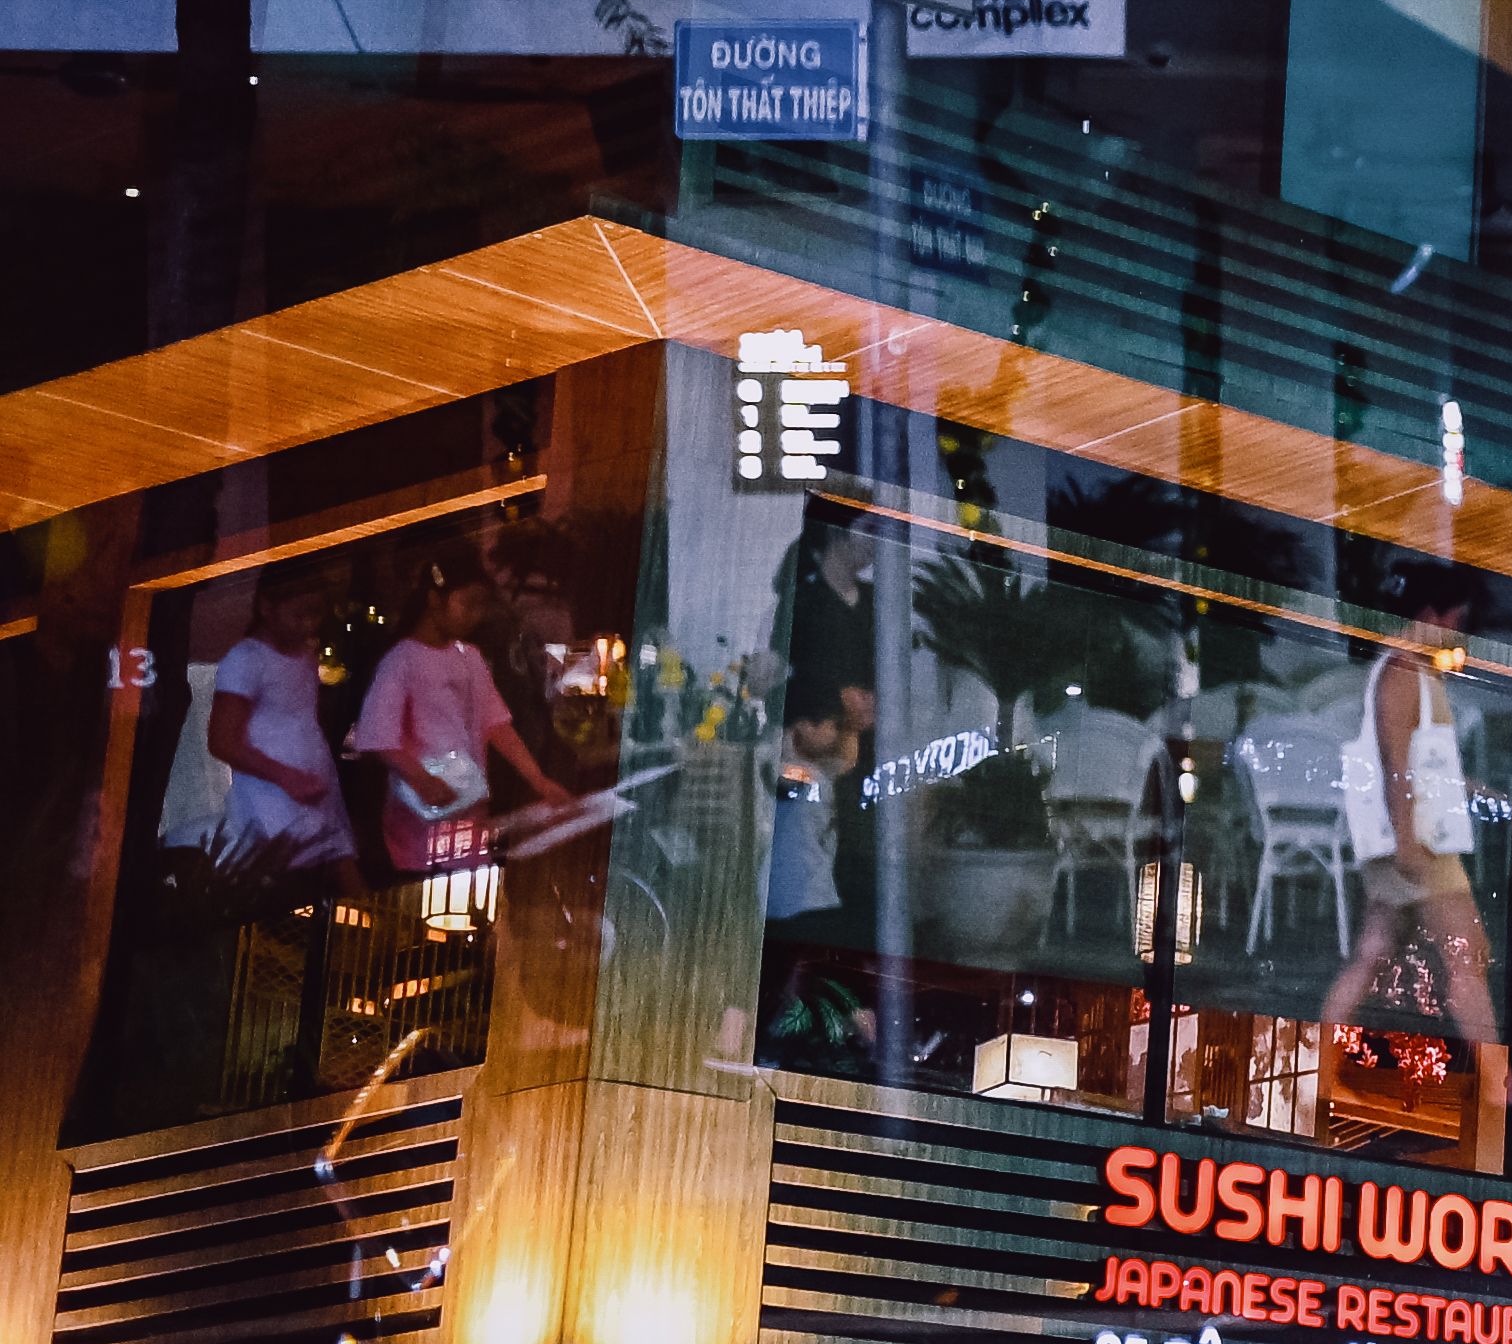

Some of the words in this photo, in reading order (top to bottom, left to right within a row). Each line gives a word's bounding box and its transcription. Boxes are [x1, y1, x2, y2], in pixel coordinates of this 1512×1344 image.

[711, 34, 822, 70] ĐƯỜNG
[680, 78, 722, 123] TÔN
[728, 74, 783, 123] THẤT
[790, 77, 852, 126] THIỆP
[107, 645, 158, 689] 13
[1104, 1146, 1343, 1254] SUSHI
[1095, 1256, 1327, 1329] JAPANESE
